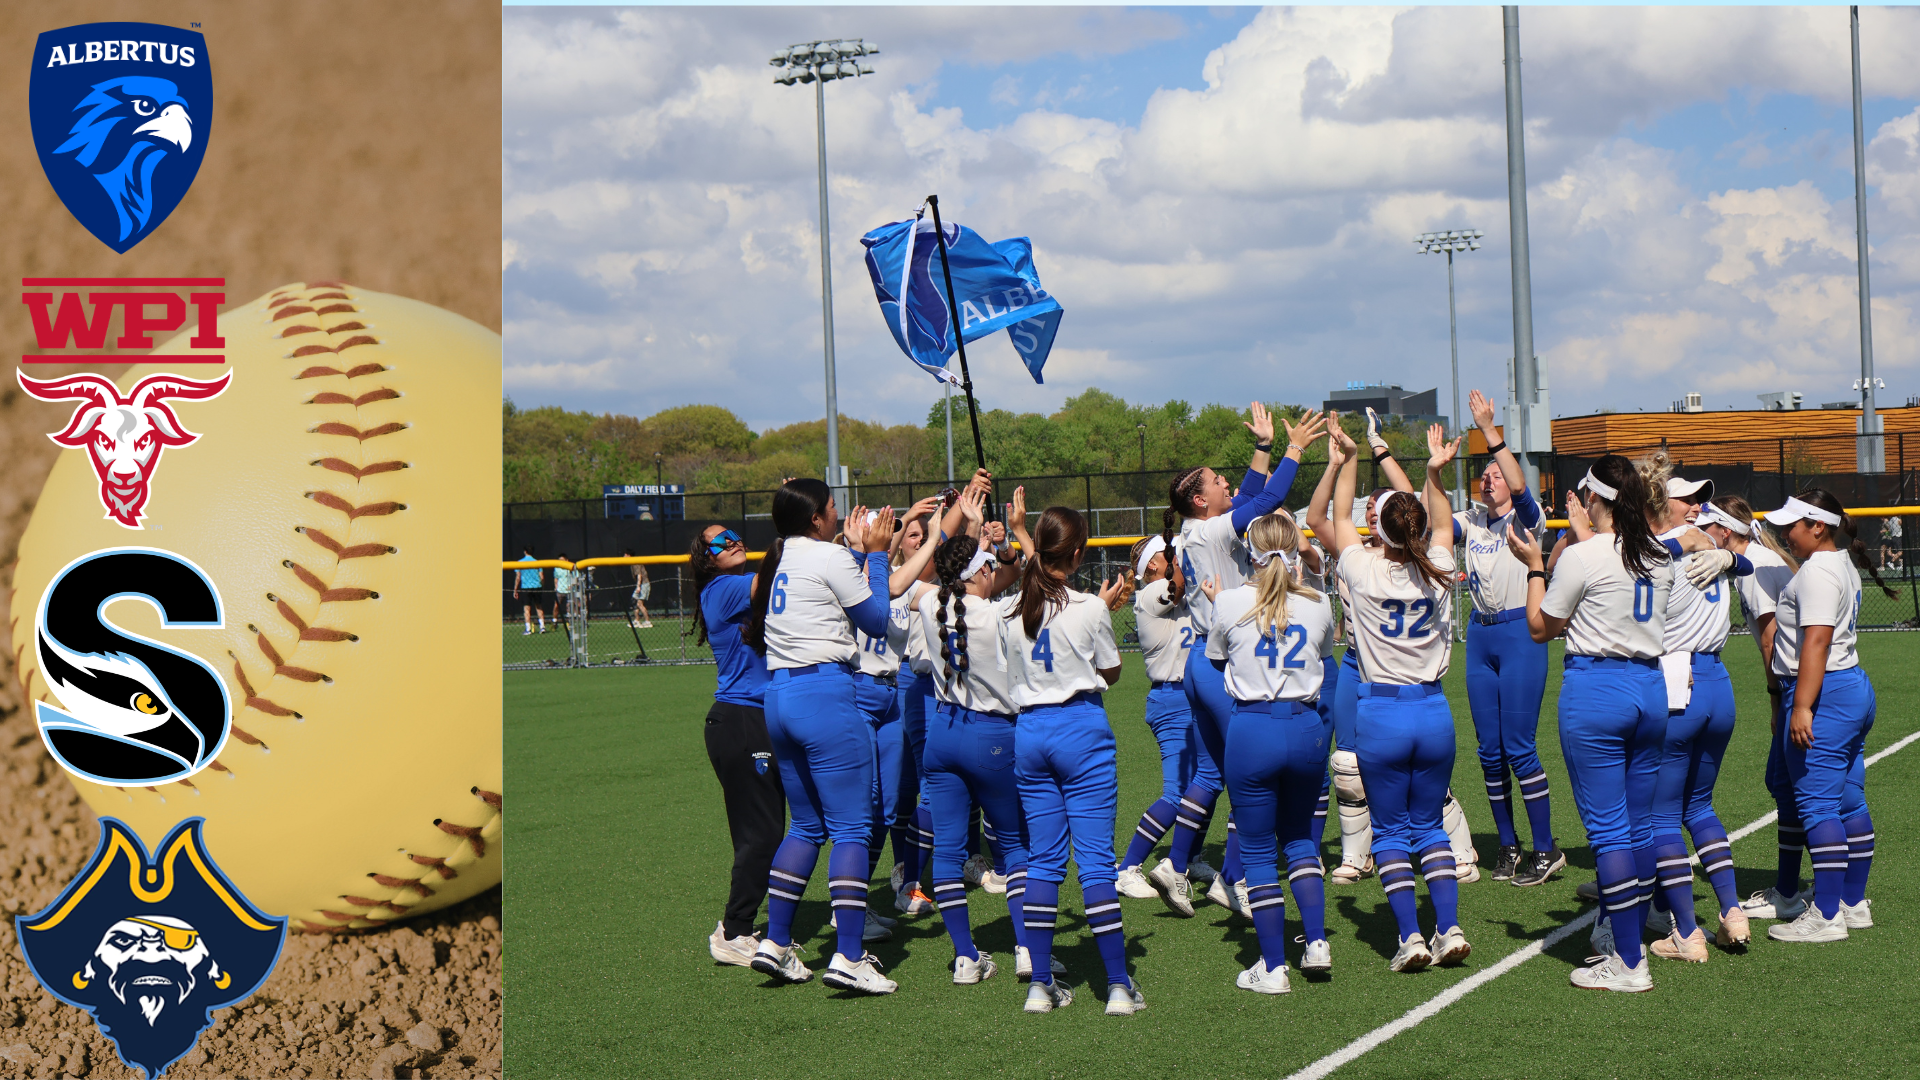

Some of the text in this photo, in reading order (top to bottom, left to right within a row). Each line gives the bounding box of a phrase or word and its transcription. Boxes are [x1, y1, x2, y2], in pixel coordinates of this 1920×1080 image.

[624, 485, 666, 493] DALY FIELD
[766, 572, 788, 614] 6
[1633, 577, 1653, 622] 0
[1380, 598, 1434, 637] 32
[1031, 628, 1053, 672] 4
[1255, 624, 1307, 668] 42
